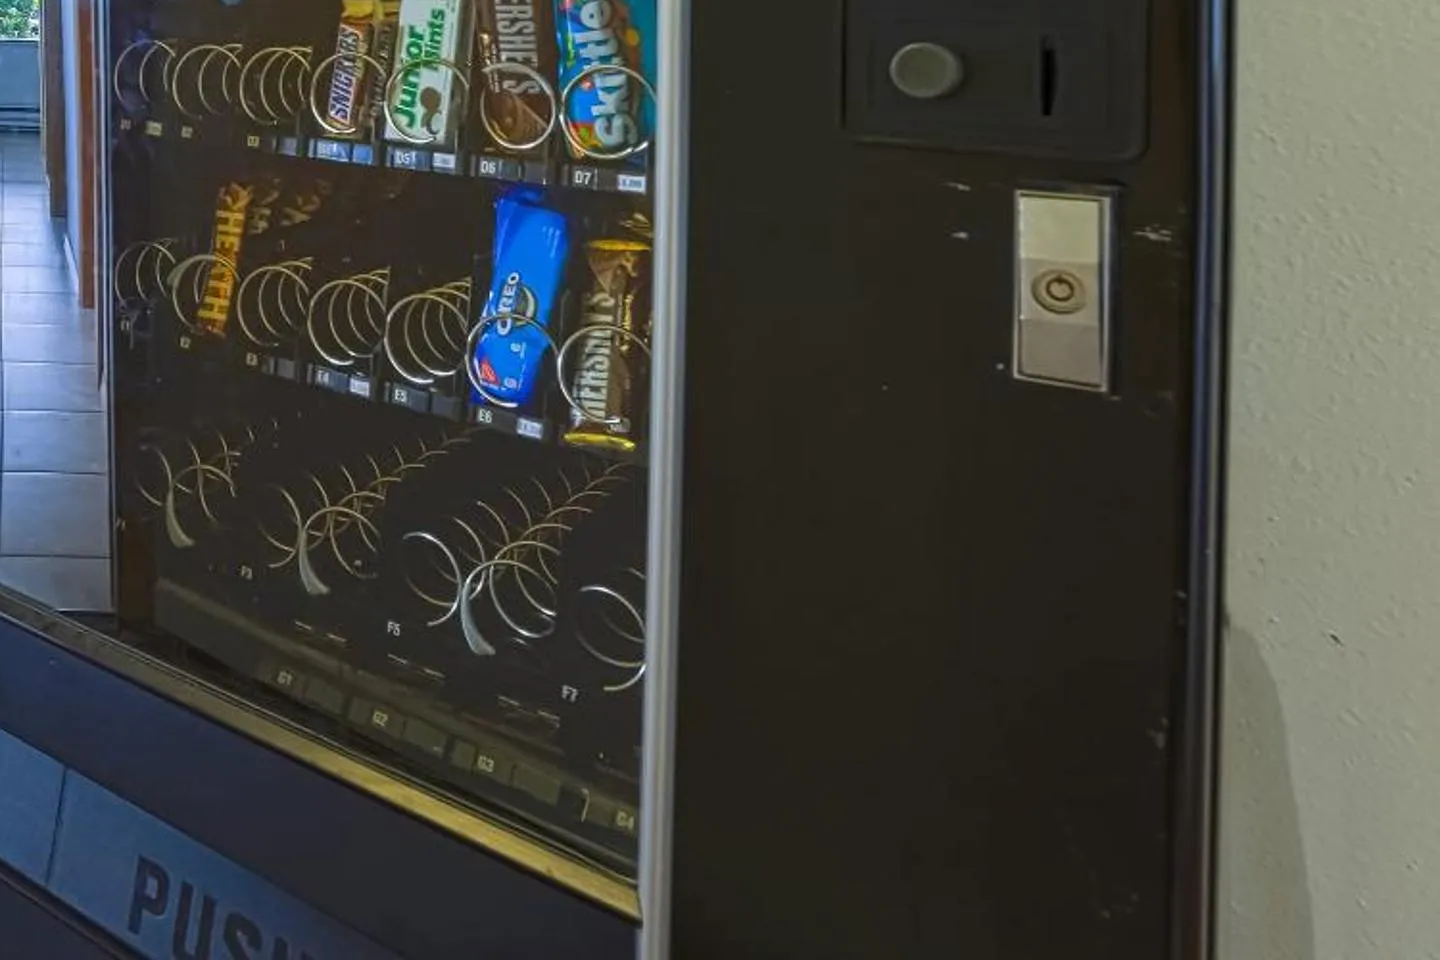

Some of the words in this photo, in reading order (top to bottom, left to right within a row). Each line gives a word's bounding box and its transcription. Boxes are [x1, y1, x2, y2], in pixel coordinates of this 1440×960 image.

[393, 24, 425, 130] Junor
[574, 169, 592, 185] D7
[496, 271, 520, 336] OREO
[128, 854, 316, 960] PUS
